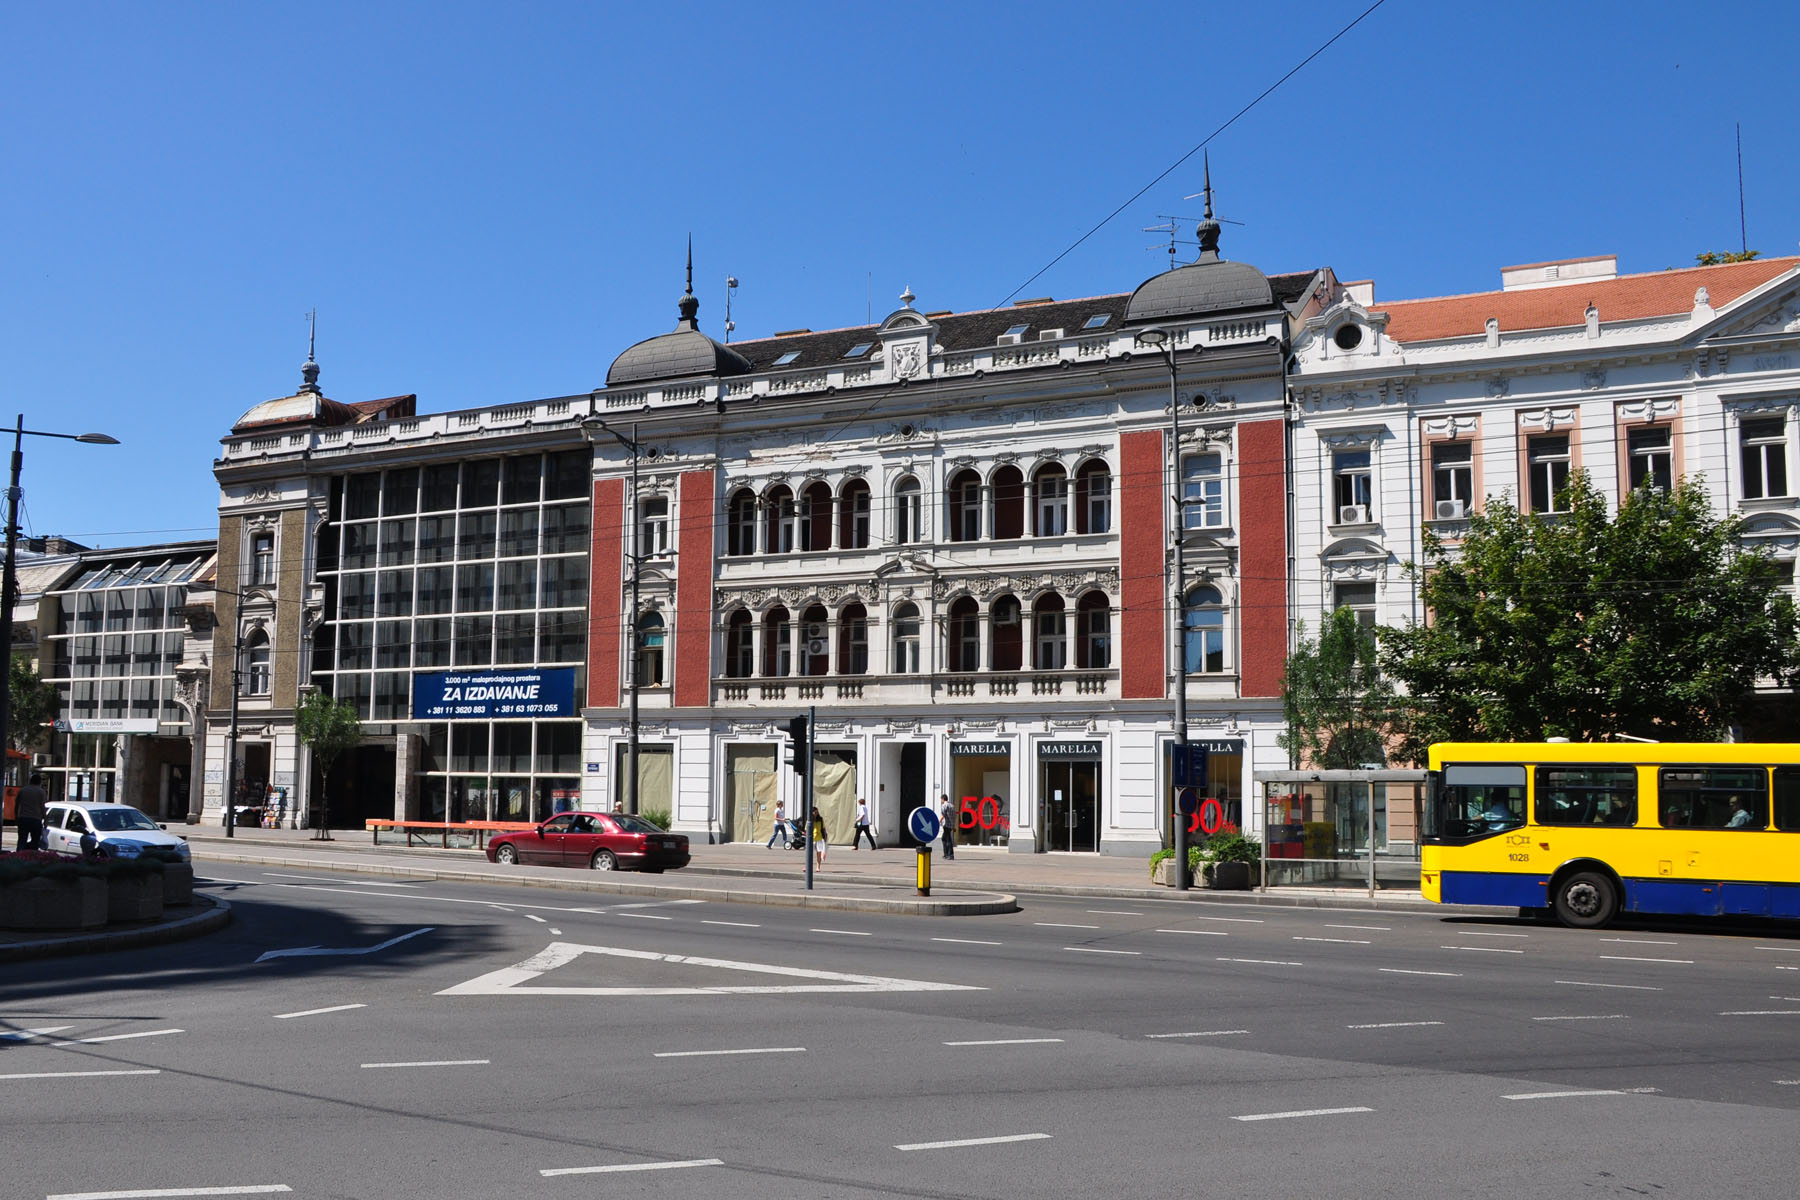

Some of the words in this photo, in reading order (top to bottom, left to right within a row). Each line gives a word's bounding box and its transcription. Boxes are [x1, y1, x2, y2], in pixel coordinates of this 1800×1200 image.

[515, 674, 541, 683] prostora
[442, 687, 462, 701] ZA
[464, 685, 540, 701] IZDAVANJE
[432, 706, 444, 714] 381
[445, 706, 453, 714] 11
[501, 704, 514, 713] 381
[526, 704, 543, 713] 1073
[544, 703, 559, 712] 055
[953, 744, 1007, 754] MARELLA
[1041, 744, 1098, 754] MARELLA
[1509, 853, 1529, 862] 1028
